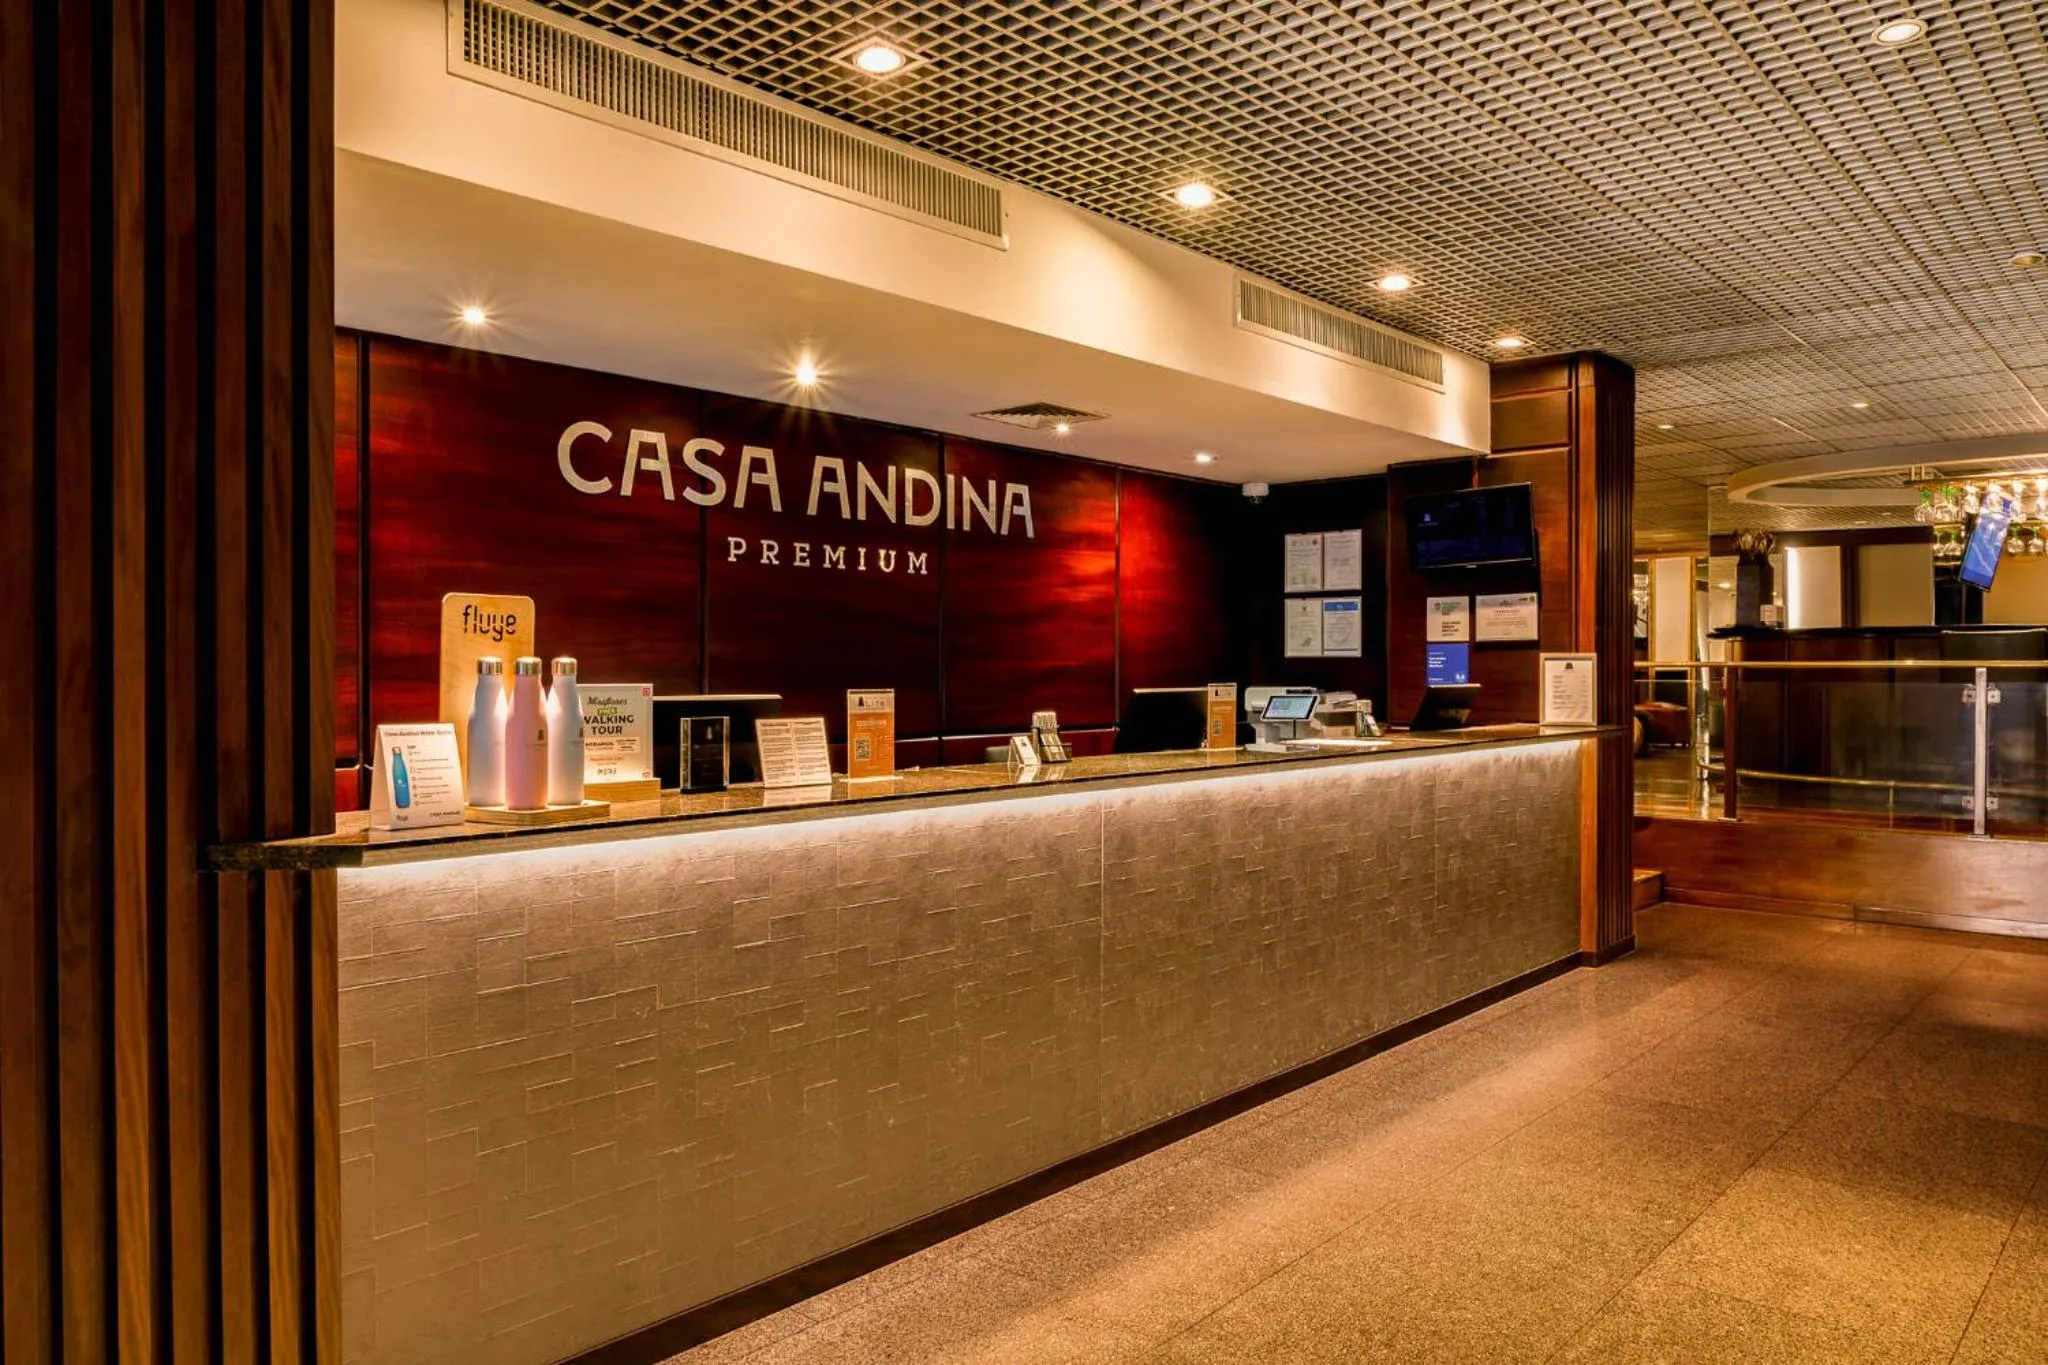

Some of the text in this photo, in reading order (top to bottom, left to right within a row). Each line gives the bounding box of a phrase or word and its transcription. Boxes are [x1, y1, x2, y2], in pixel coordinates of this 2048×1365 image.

[557, 420, 1035, 539] CASA ANDINA
[727, 536, 929, 575] PREMIUM
[462, 604, 517, 642] fluye
[591, 725, 623, 735] TOUR
